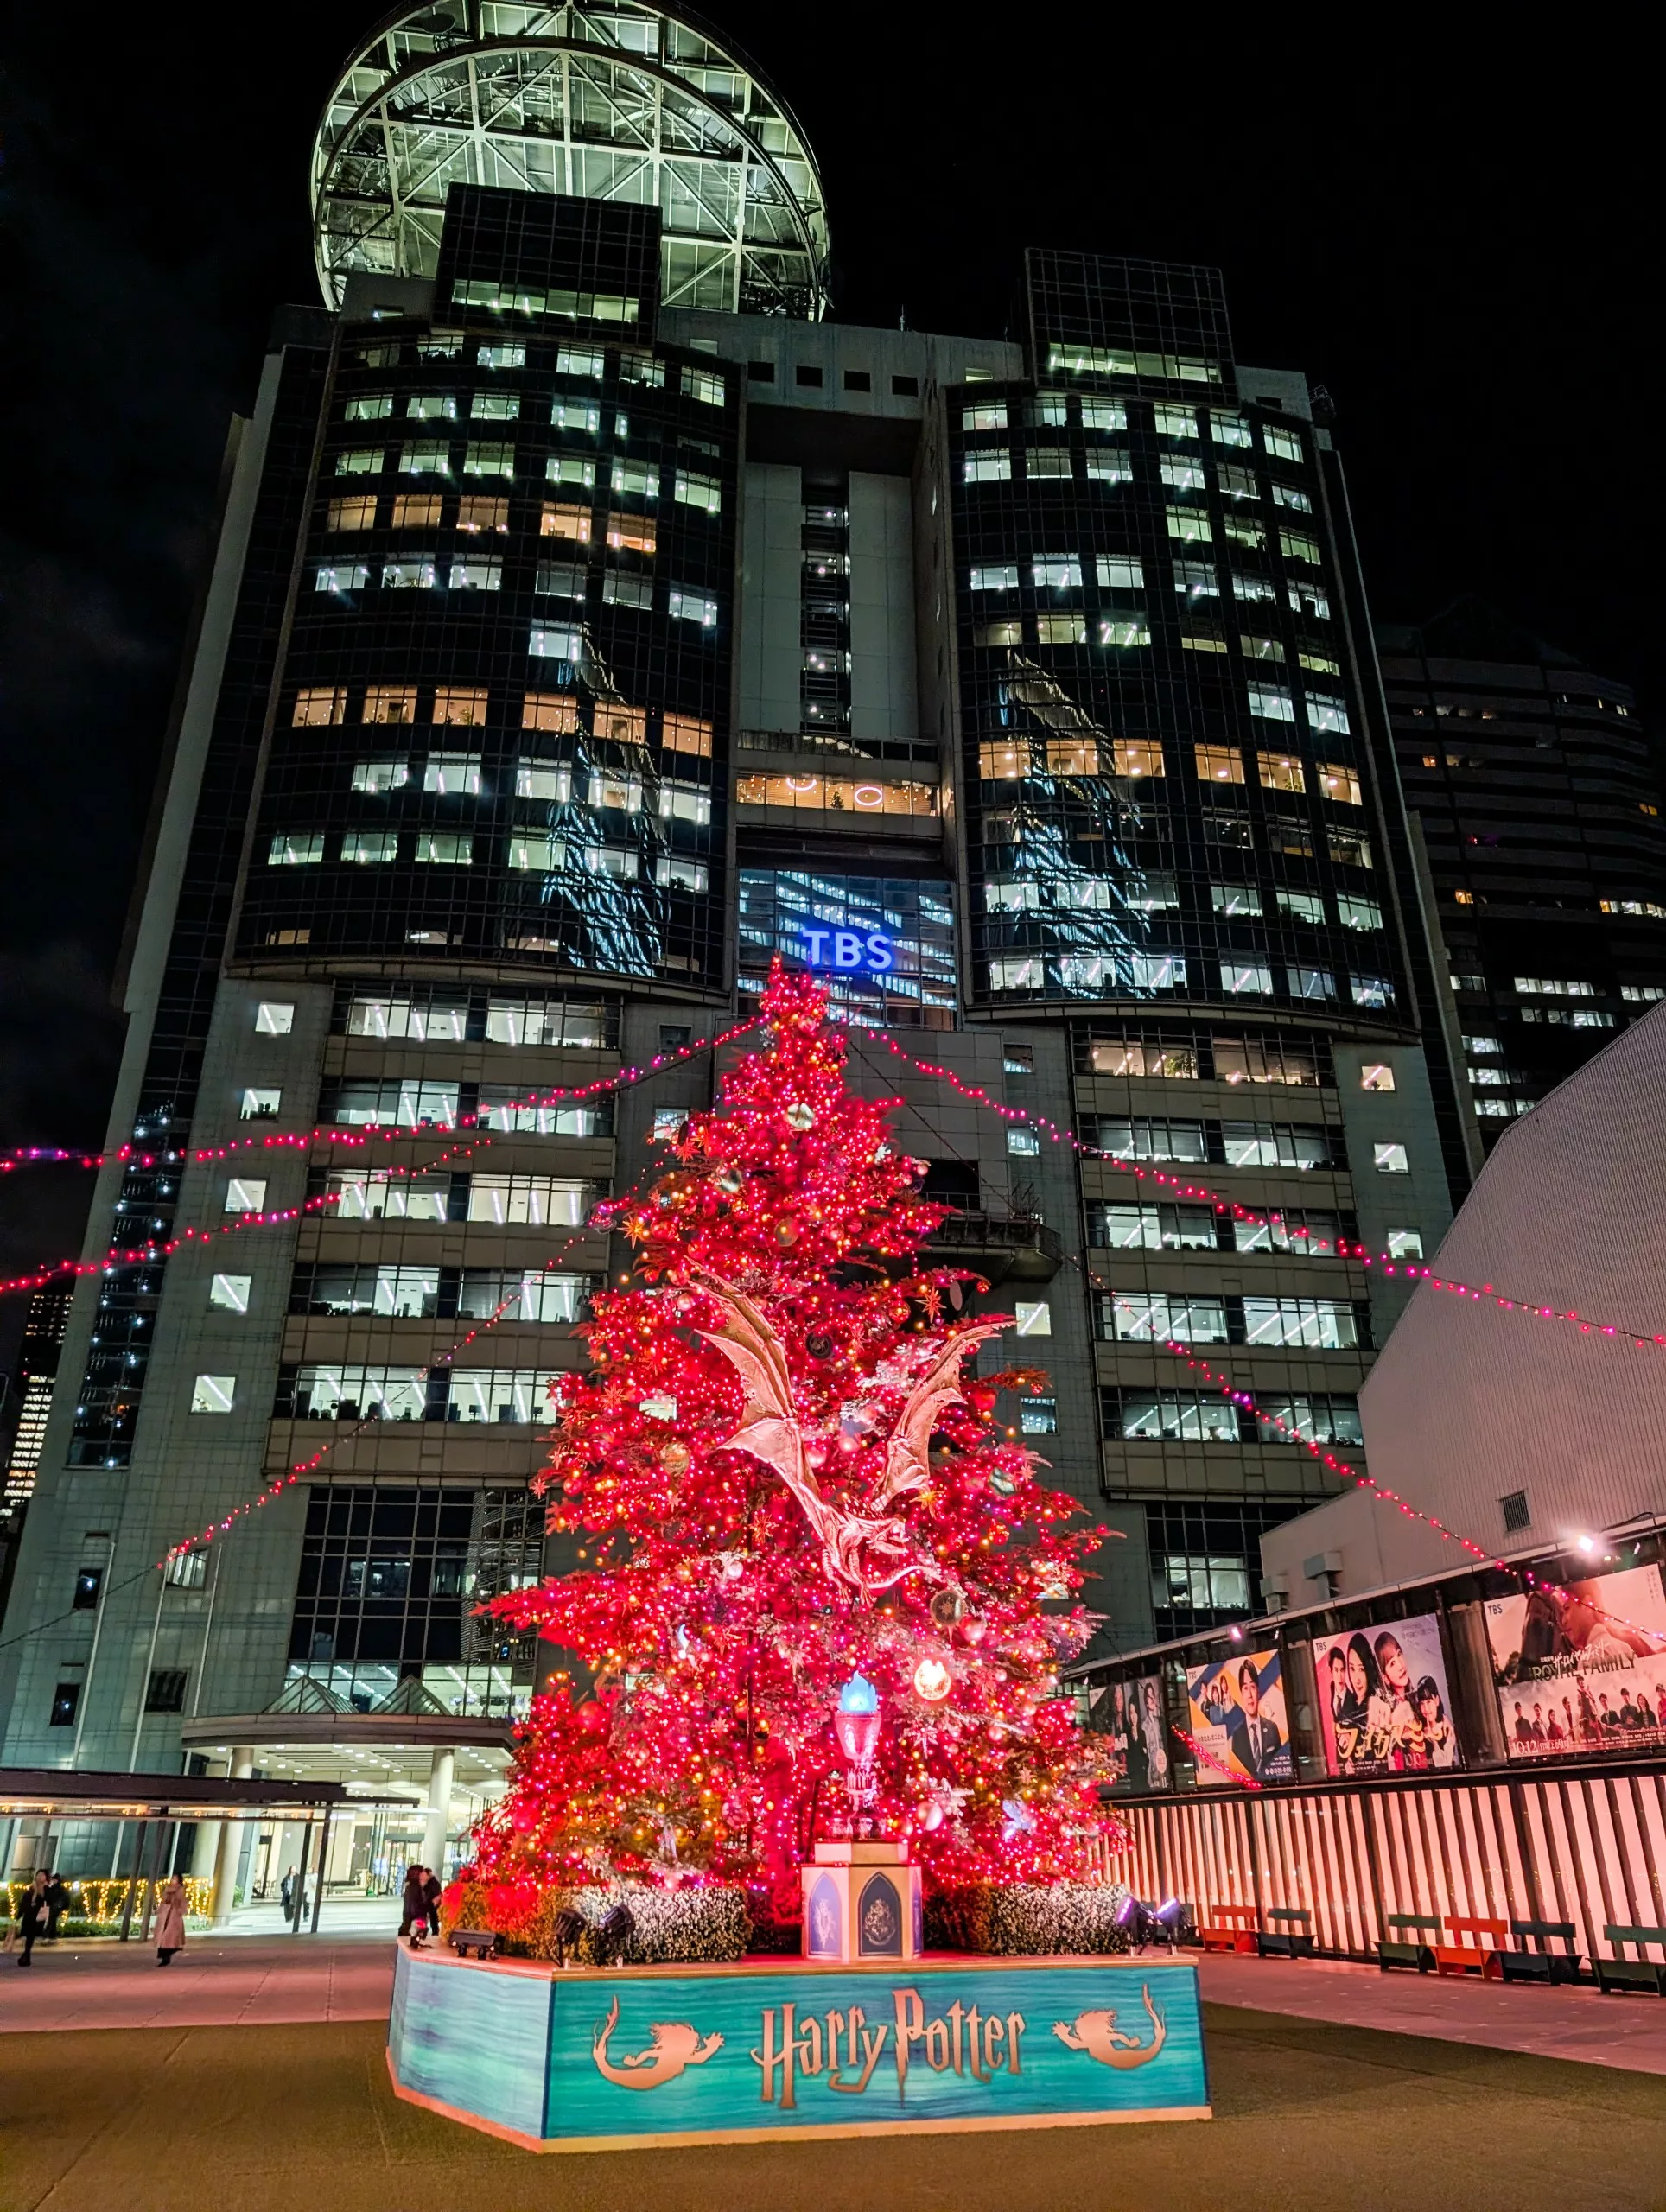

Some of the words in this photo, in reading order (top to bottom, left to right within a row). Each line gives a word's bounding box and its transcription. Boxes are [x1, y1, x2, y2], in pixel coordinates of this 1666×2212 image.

[803, 930, 892, 969] TBS
[1487, 1604, 1503, 1616] TBS
[1316, 1642, 1327, 1653] TBS
[1532, 1660, 1580, 1682] ROYAL
[1584, 1651, 1637, 1675] FAMILY
[751, 2003, 888, 2109] Harry
[892, 1988, 1027, 2109] Potter
